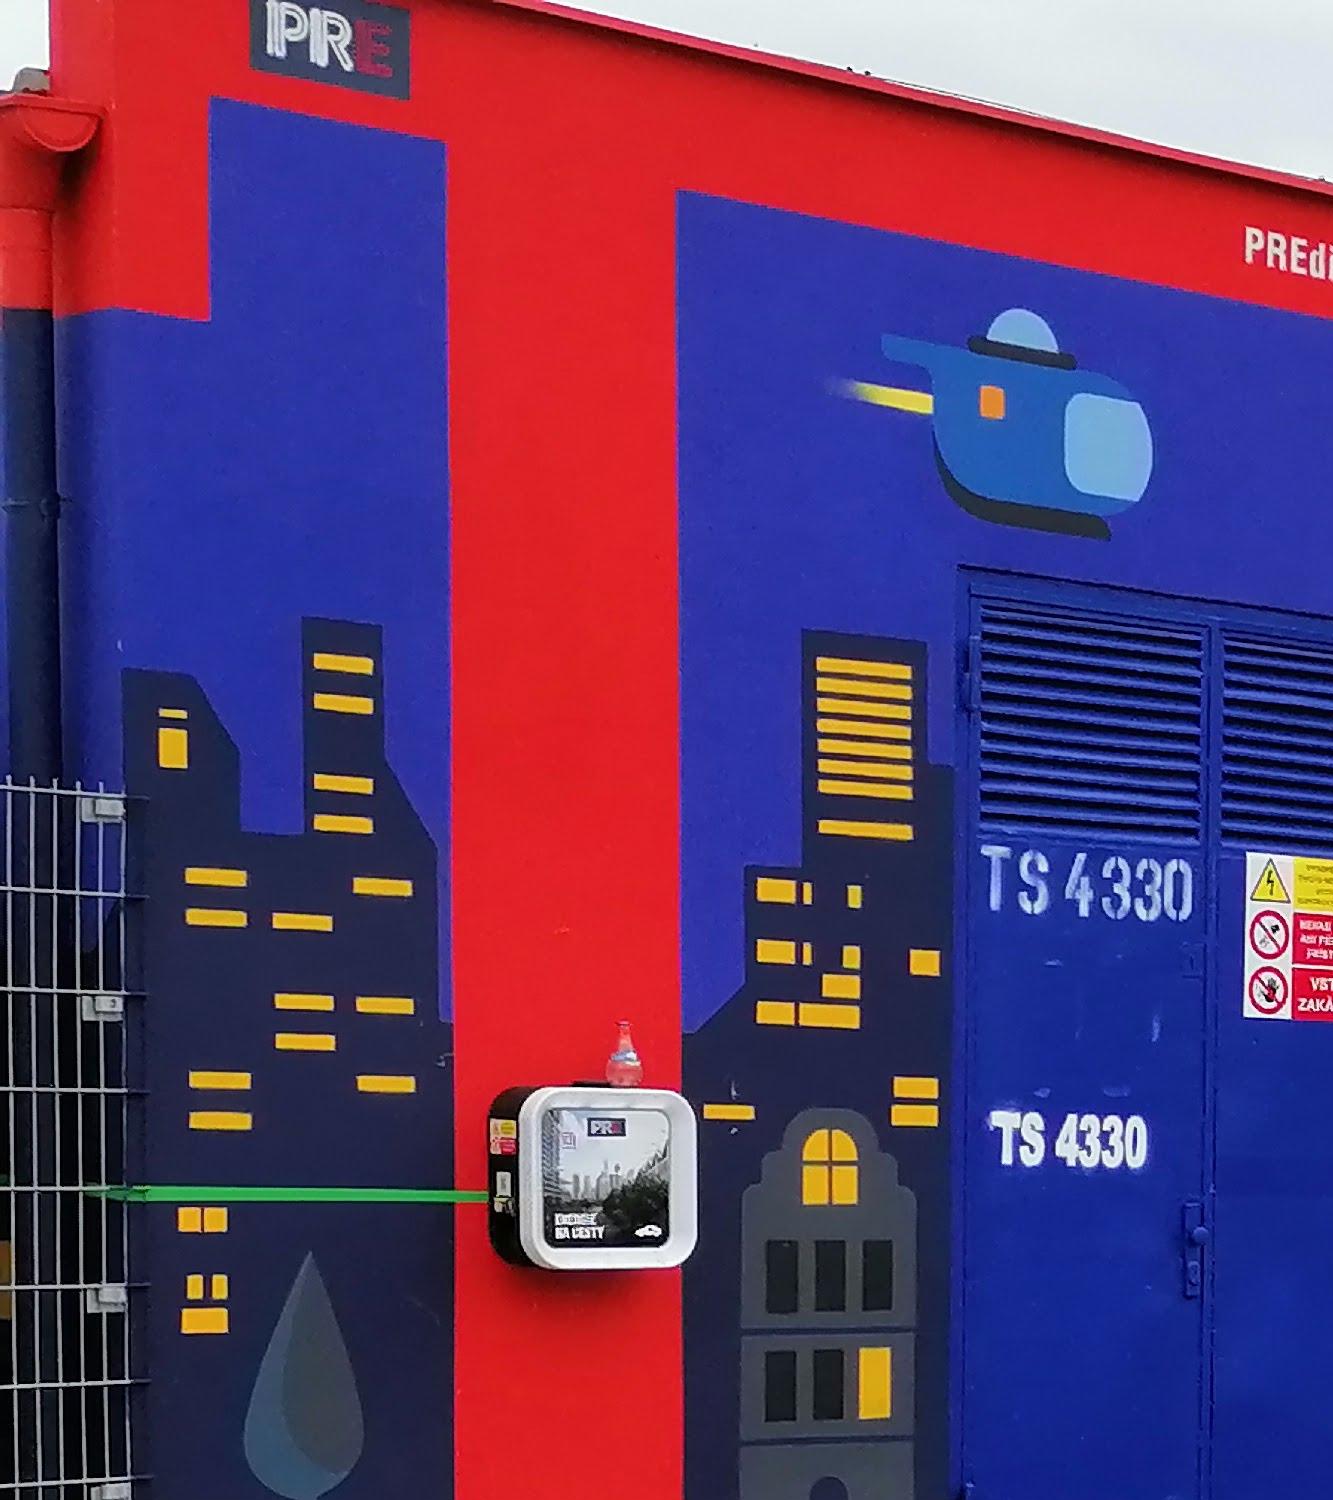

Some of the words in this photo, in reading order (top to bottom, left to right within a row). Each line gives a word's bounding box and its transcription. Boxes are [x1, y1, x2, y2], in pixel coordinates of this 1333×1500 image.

[266, 0, 393, 78] PRE
[980, 844, 1049, 915] TS
[1065, 852, 1193, 922] 4330
[990, 1110, 1046, 1167] TS
[1055, 1113, 1148, 1169] 4330
